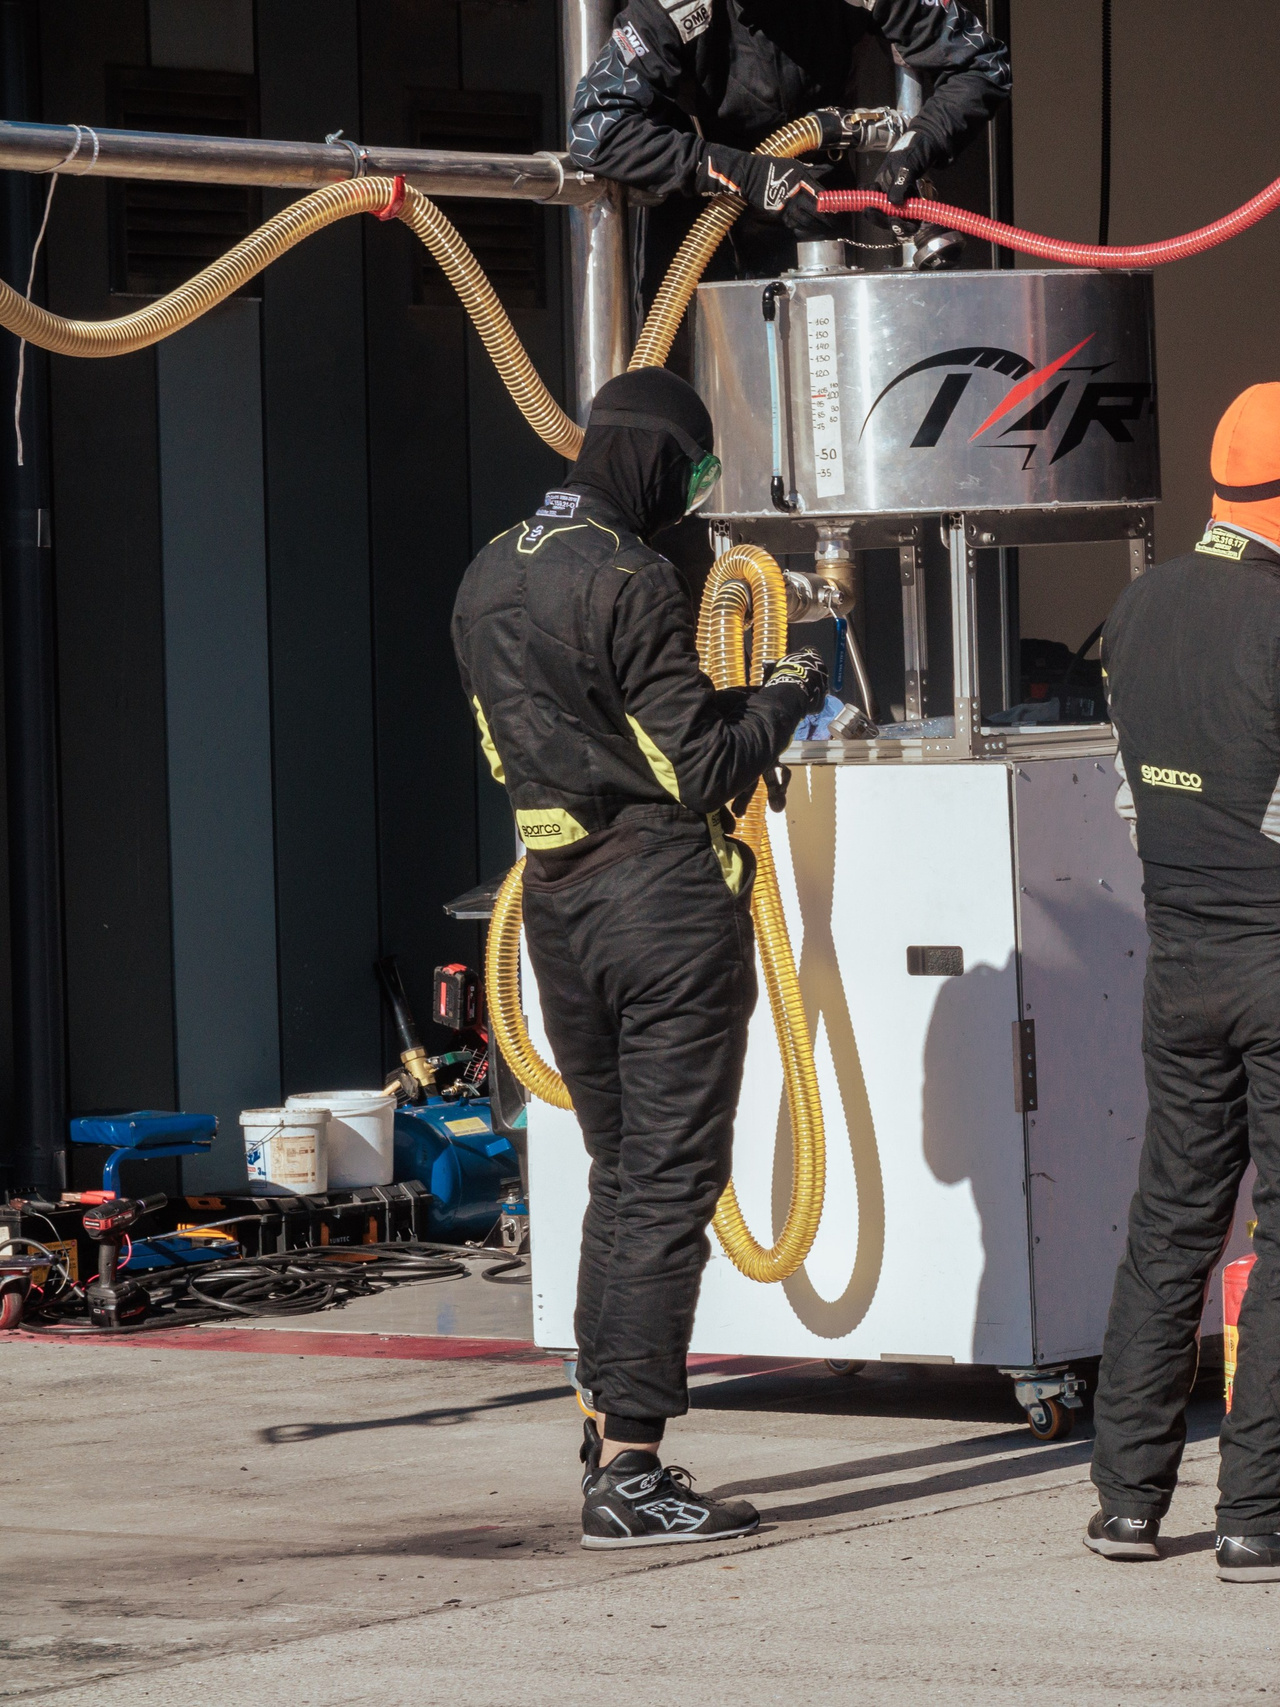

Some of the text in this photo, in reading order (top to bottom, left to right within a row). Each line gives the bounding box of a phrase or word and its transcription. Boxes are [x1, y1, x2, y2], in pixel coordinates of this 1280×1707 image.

[683, 8, 709, 31] OMP
[815, 318, 830, 326] 160
[815, 331, 829, 339] 150
[815, 369, 830, 377] 120
[820, 448, 837, 461] 50
[820, 468, 832, 478] 35
[1141, 764, 1202, 790] sparco
[522, 823, 562, 838] sparco
